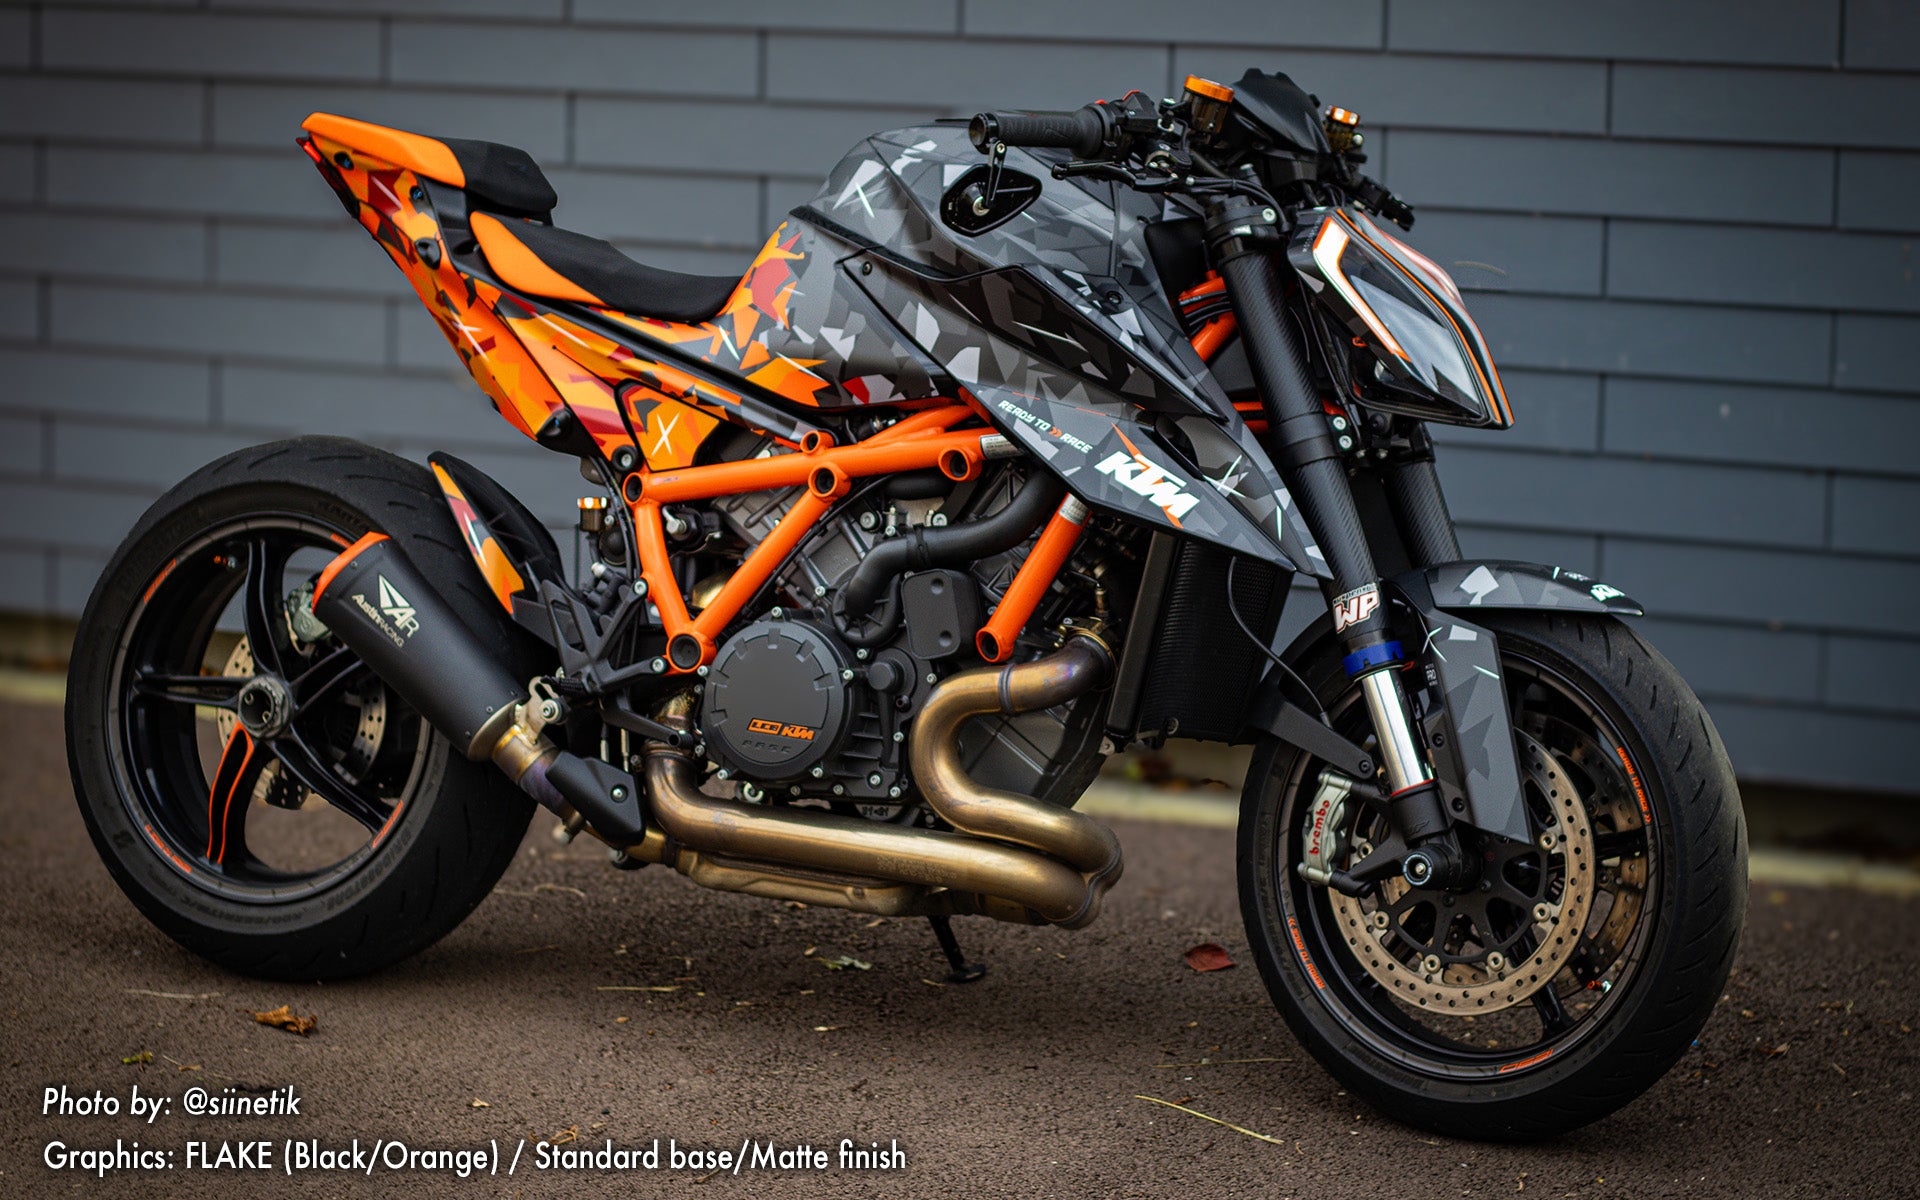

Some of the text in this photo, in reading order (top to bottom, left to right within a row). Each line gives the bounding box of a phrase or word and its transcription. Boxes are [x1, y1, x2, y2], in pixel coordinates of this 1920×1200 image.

[998, 400, 1094, 454] READY TO RACE
[1094, 451, 1200, 518] KTM
[1333, 590, 1380, 634] WP
[781, 725, 815, 741] KTM
[1309, 800, 1330, 855] brembo
